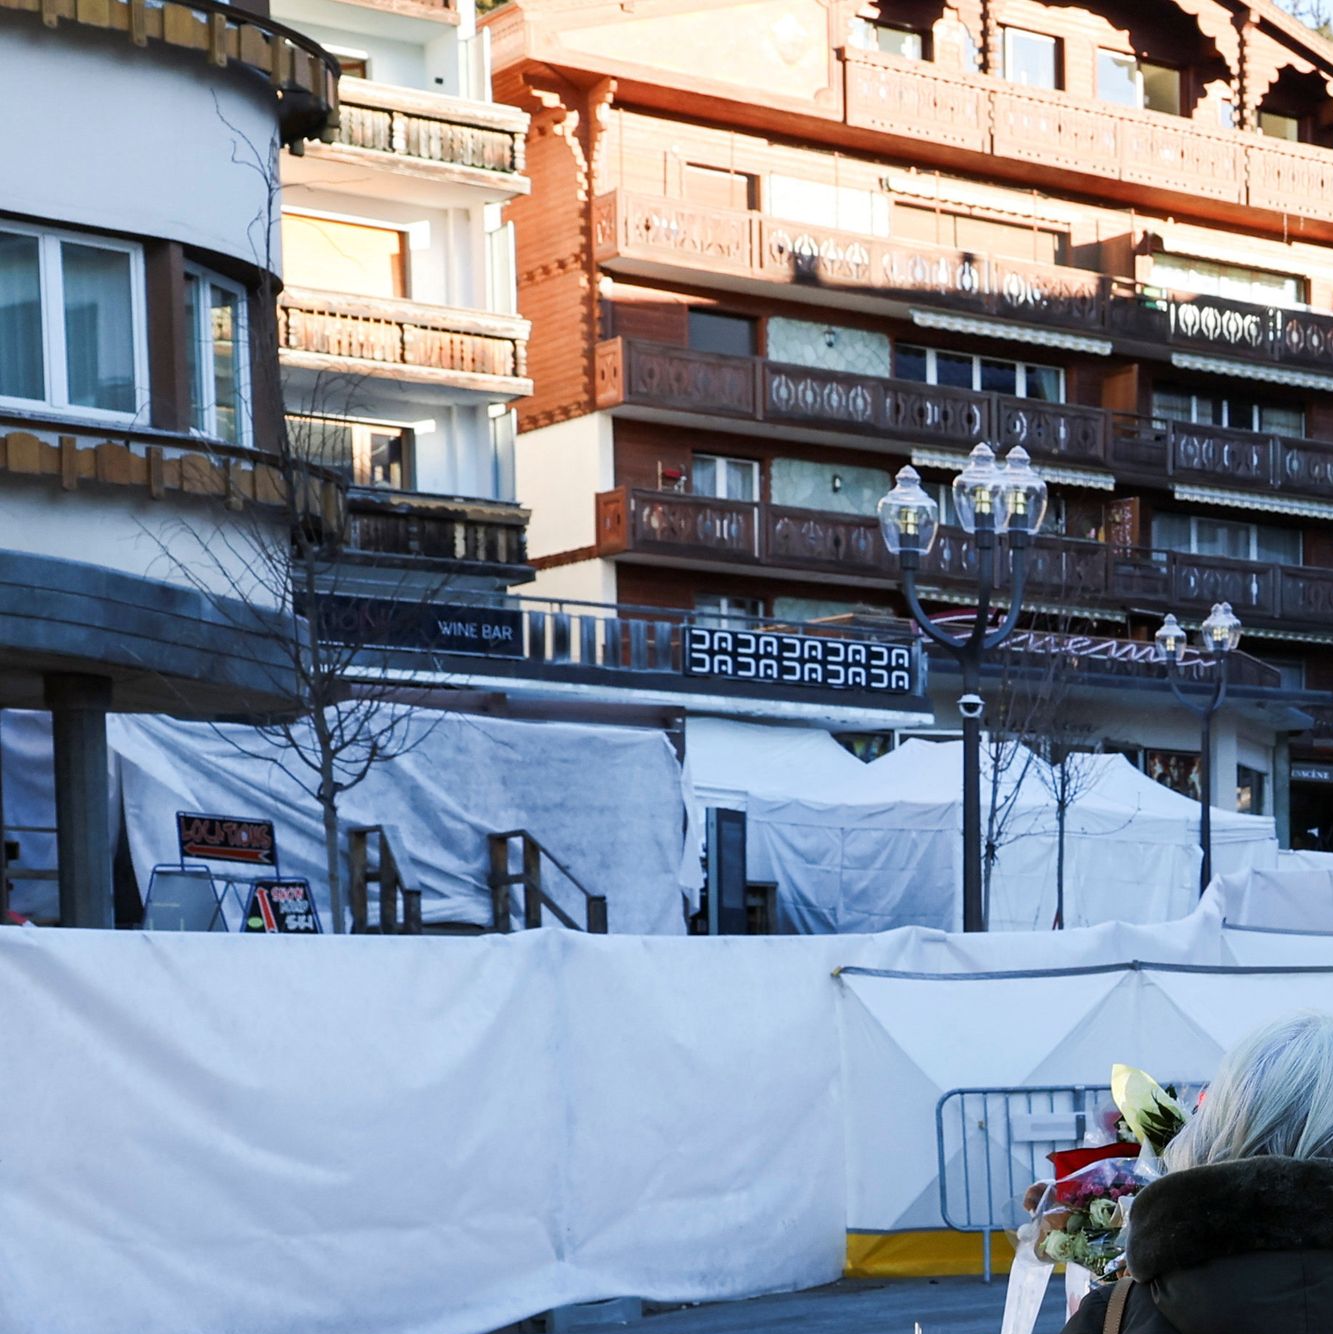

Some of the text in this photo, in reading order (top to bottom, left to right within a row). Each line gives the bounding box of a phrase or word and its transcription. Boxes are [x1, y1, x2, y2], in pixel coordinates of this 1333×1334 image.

[438, 620, 513, 641] WINE BAR
[181, 817, 272, 849] LOCATIONS
